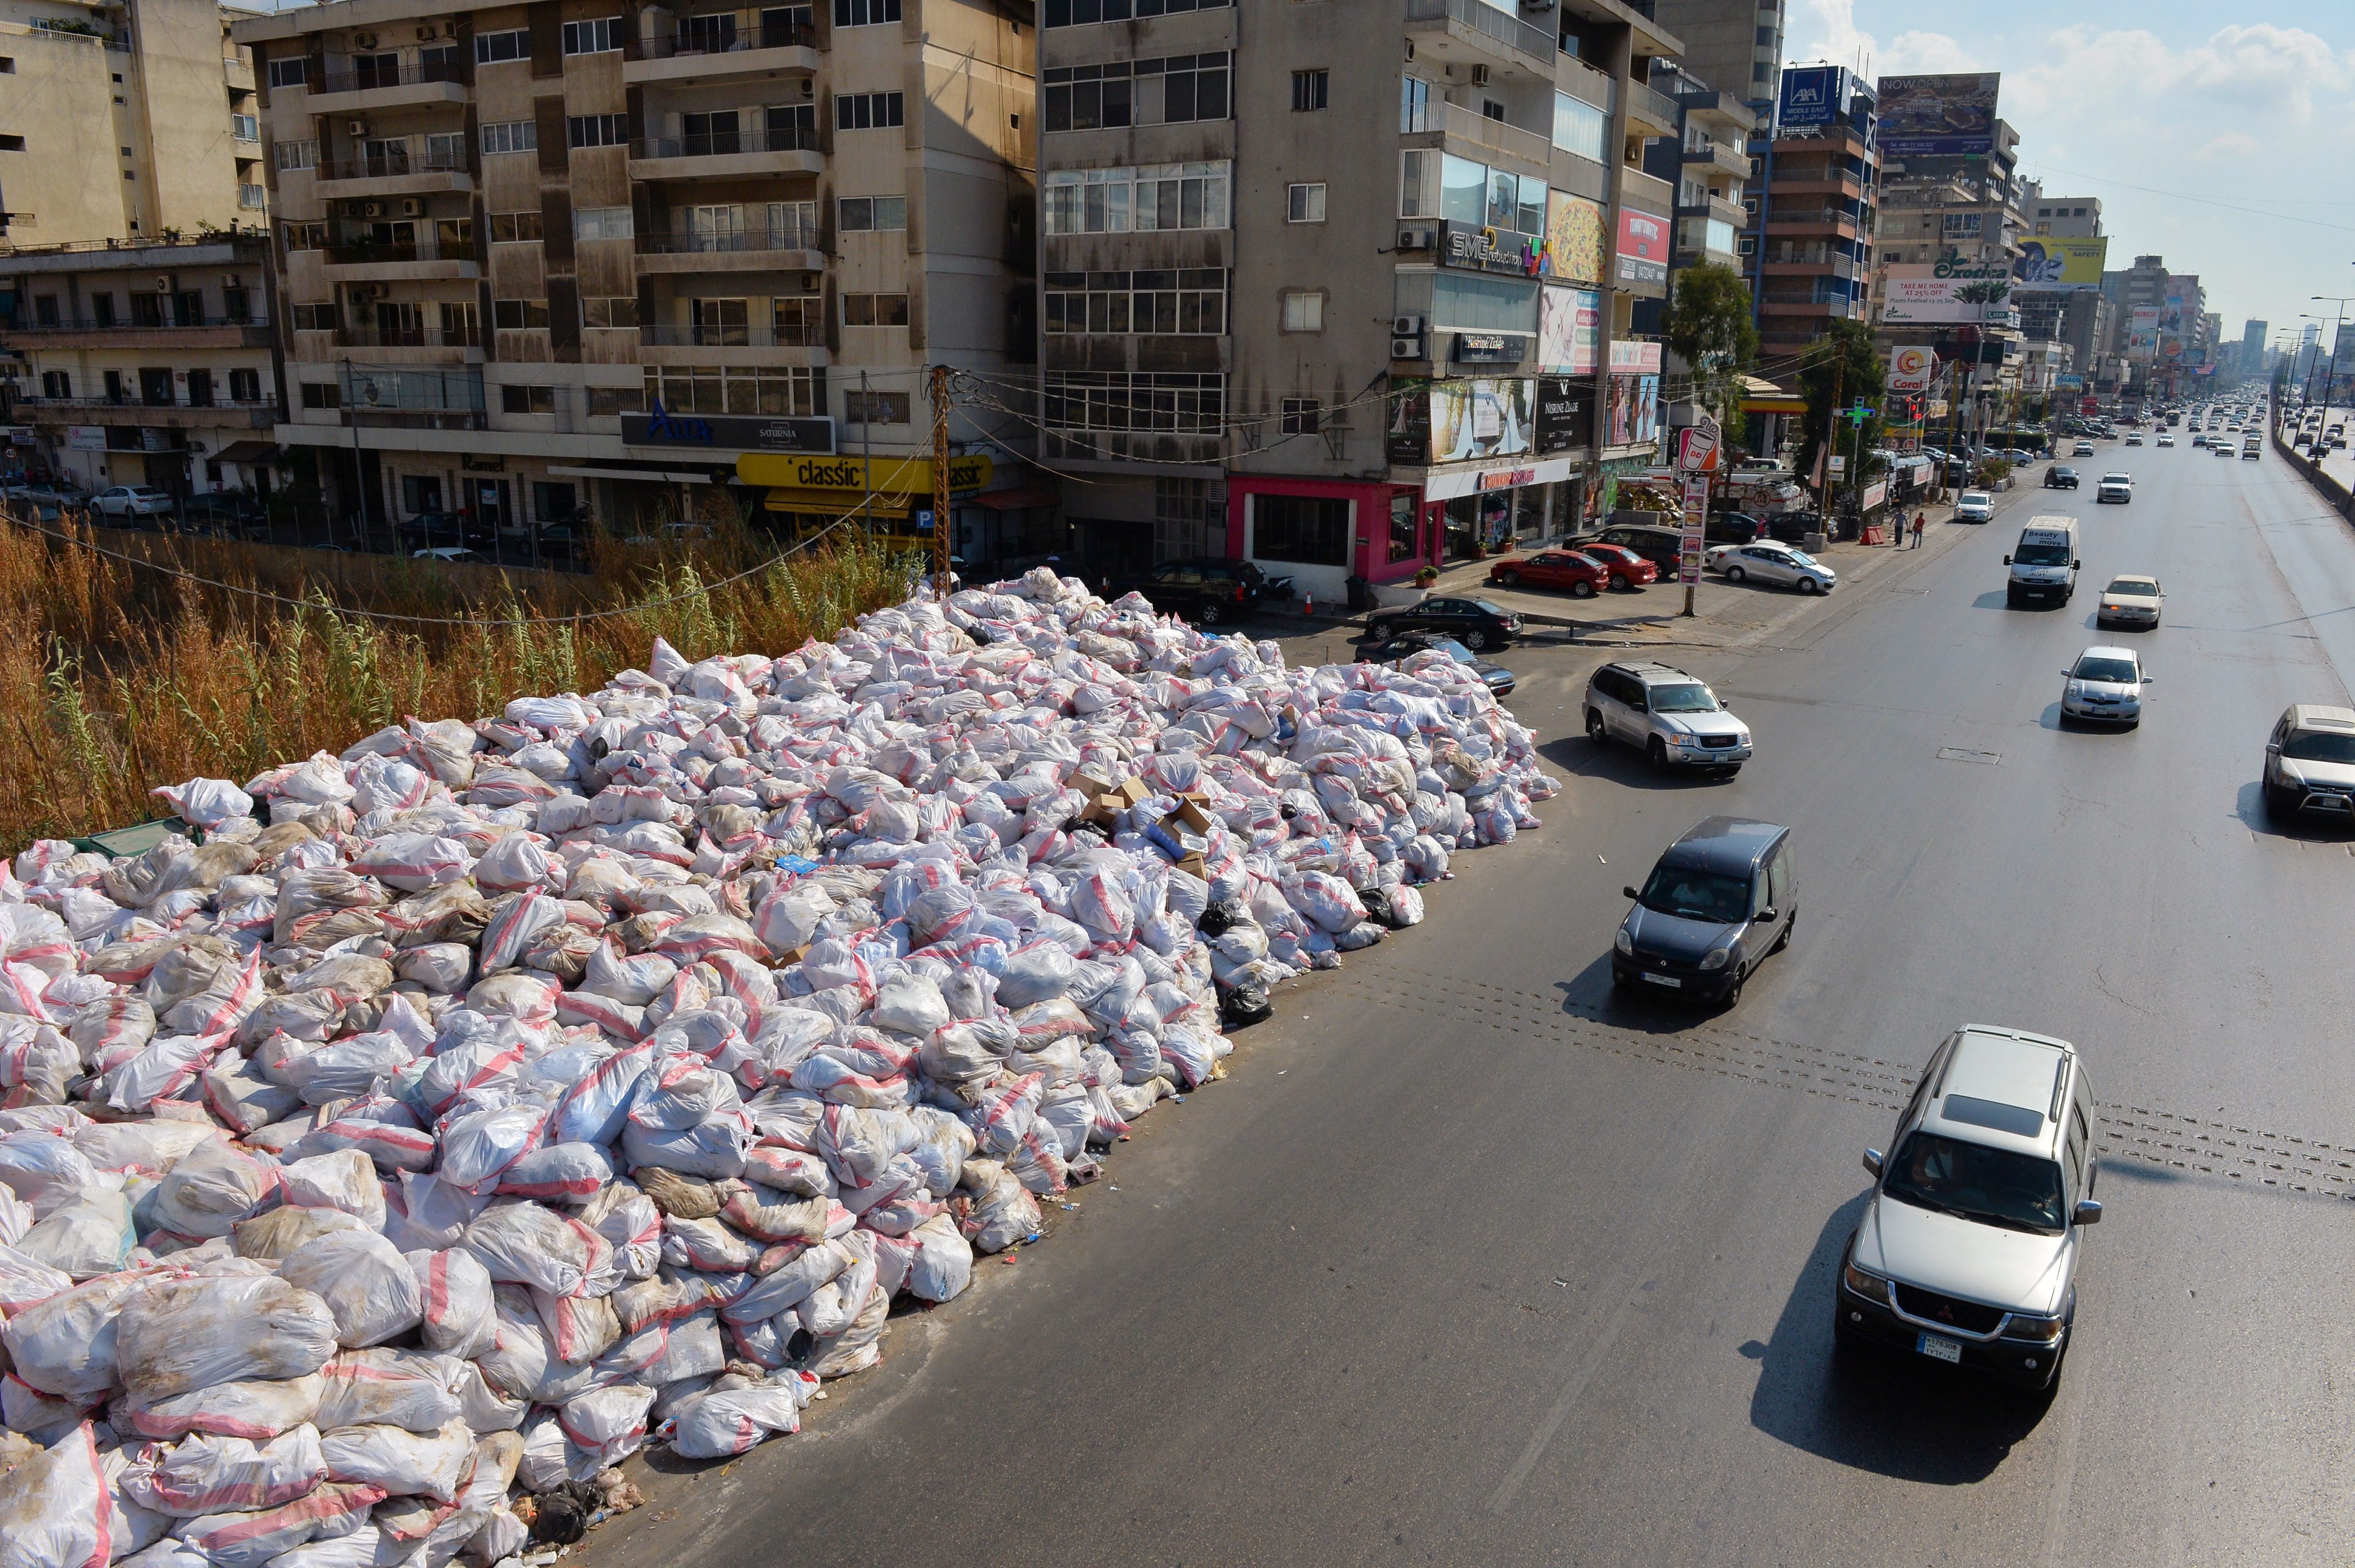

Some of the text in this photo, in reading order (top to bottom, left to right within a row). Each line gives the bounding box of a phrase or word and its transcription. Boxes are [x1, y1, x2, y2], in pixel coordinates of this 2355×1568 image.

[1883, 78, 1950, 90] NOW OPEN
[1792, 88, 1818, 101] AXA
[1451, 231, 1489, 260] SMG
[1893, 379, 1923, 389] Coral
[1545, 401, 1579, 414] NISRINE ZIADE
[760, 429, 797, 438] SATURNIA
[1690, 450, 1702, 458] DD
[462, 453, 505, 473] Ramel
[798, 460, 860, 486] classic
[1487, 469, 1535, 489] DUNKIN' DONUTS
[920, 512, 931, 526] P
[2028, 531, 2058, 539] Beauty
